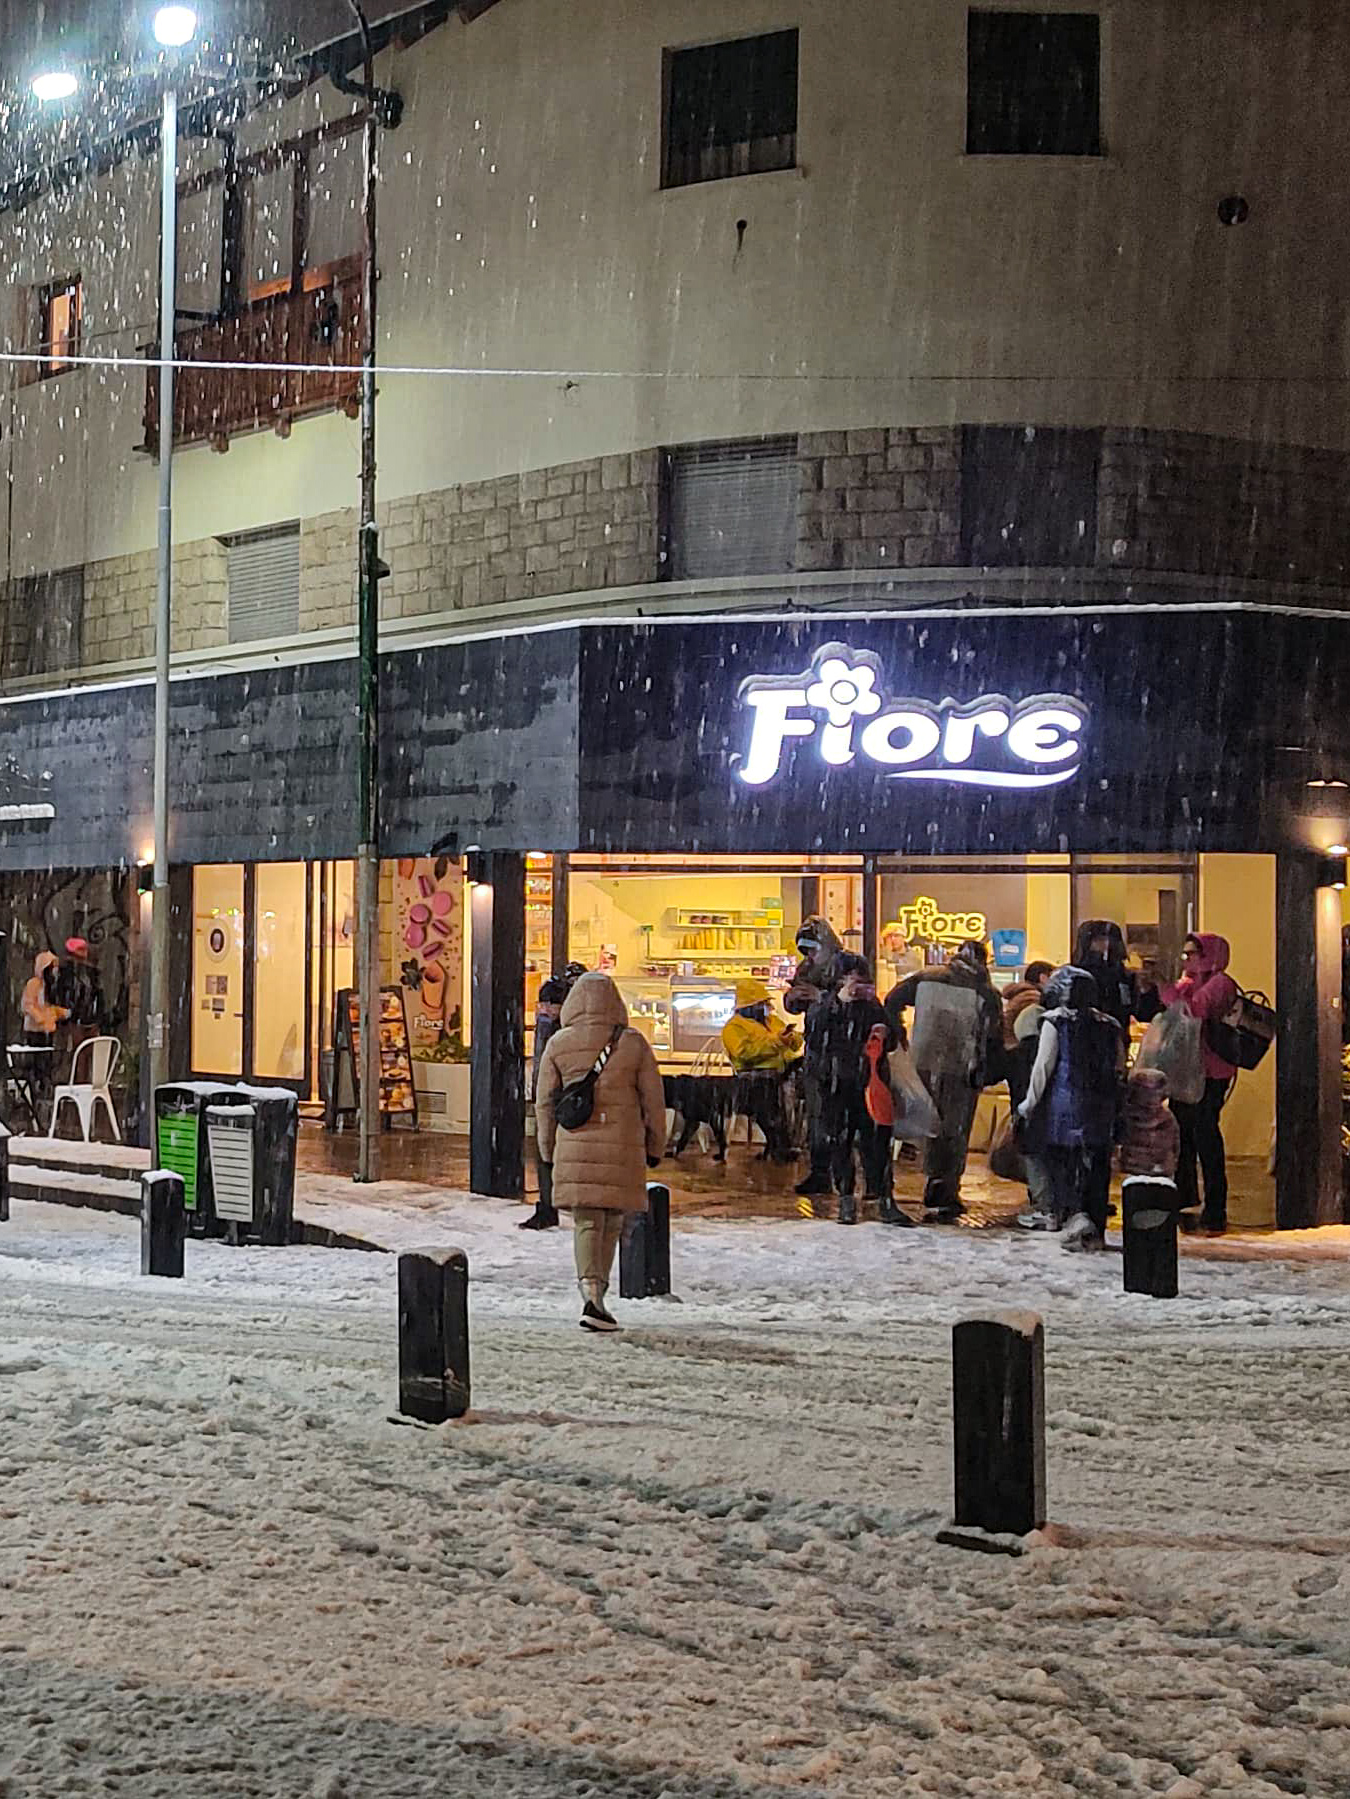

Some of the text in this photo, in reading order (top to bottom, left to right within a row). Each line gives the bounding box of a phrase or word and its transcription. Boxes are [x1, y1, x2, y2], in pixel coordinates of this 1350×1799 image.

[738, 659, 1083, 786] Fiore
[900, 897, 986, 943] Fiore
[413, 1014, 444, 1030] Fiore
